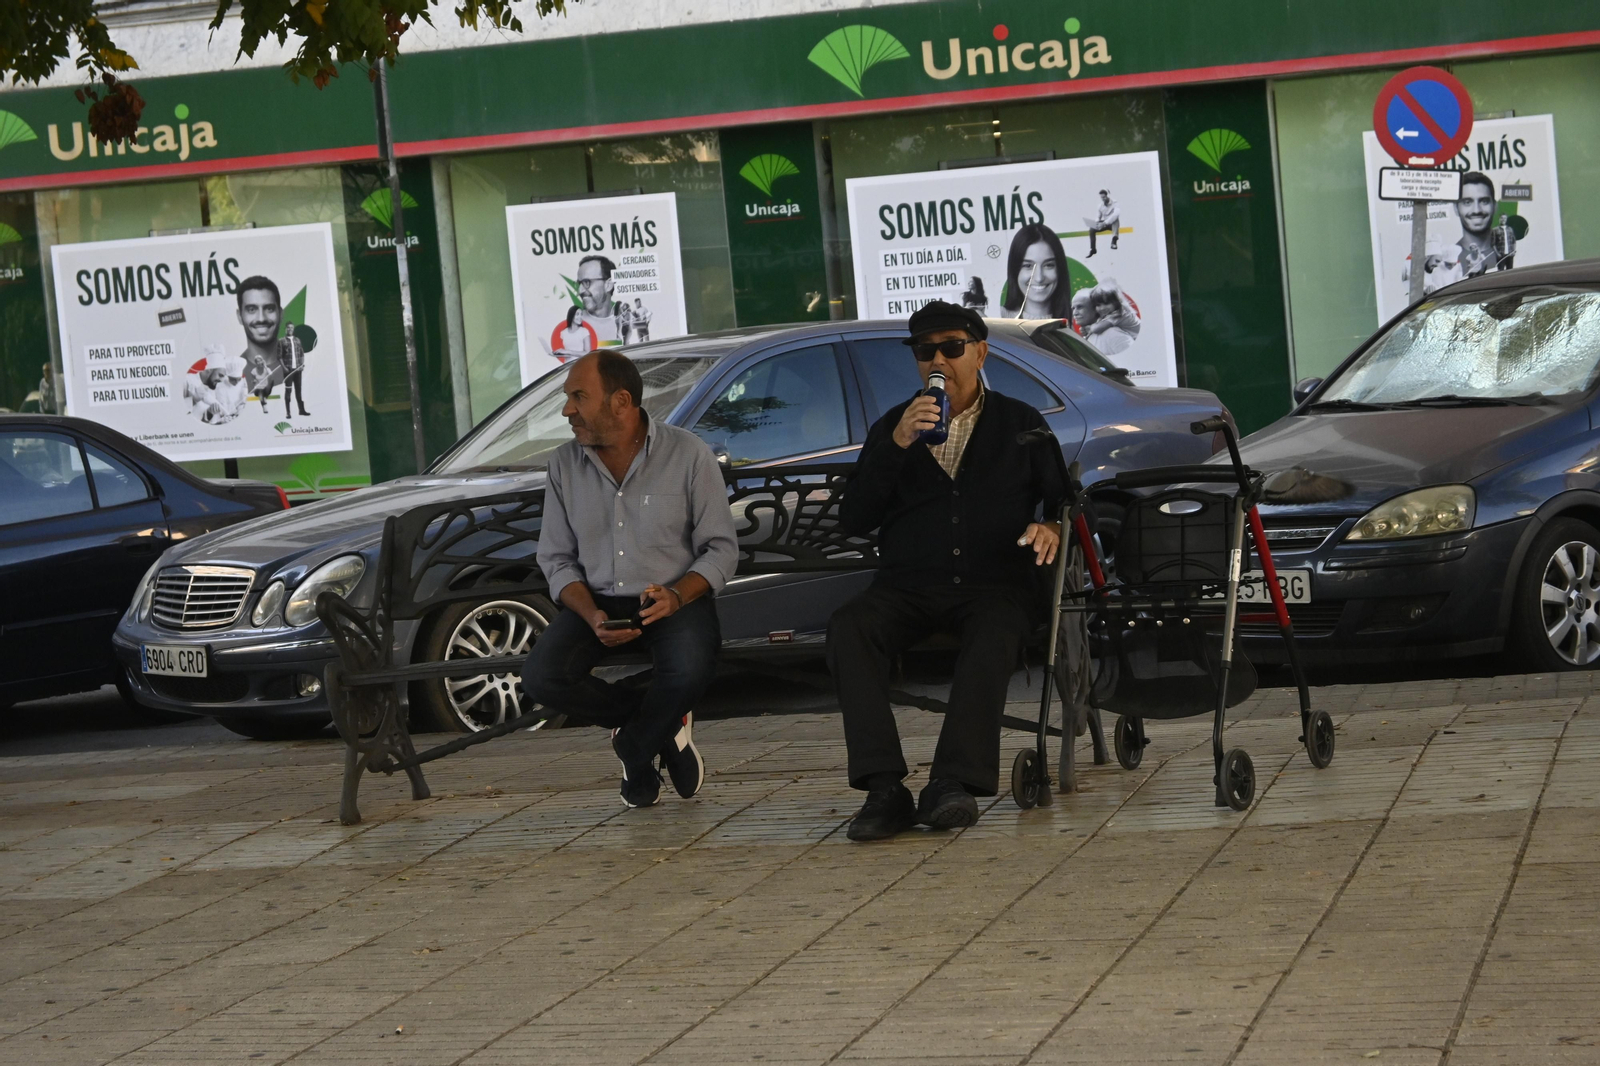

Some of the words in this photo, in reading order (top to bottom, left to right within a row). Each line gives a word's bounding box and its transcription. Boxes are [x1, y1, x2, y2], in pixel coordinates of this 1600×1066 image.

[921, 17, 1112, 80] Unicaja
[1477, 134, 1527, 171] MÁS
[1193, 174, 1252, 194] Unicaja
[1505, 188, 1530, 197] ABIERTO
[745, 198, 801, 217] Unicaja
[879, 197, 975, 241] SOMOS
[982, 185, 1045, 232] MÁS
[530, 224, 604, 256] SOMOS
[610, 216, 658, 250] MÁS
[622, 255, 656, 265] CERCANOS.
[884, 253, 898, 267] EN
[900, 252, 914, 266] TU
[916, 248, 934, 264] DÍA
[936, 250, 944, 263] A
[946, 245, 967, 262] DÍA.
[76, 263, 172, 306] SOMOS
[179, 252, 241, 298] MÁS
[614, 269, 658, 279] INNOVADORES.
[886, 277, 900, 291] EN
[902, 276, 916, 289] TU
[918, 272, 960, 288] TIEMPO.
[617, 283, 659, 293] SOSTENIBLES.
[888, 301, 902, 314] EN
[904, 299, 918, 313] TU
[89, 347, 112, 359] PARA
[113, 346, 126, 358] TU
[126, 343, 174, 357] PROYECTO.
[91, 368, 115, 381] PARA
[116, 367, 128, 379] TU
[129, 364, 170, 378] NEGOCIO.
[93, 389, 117, 402] PARA
[118, 388, 130, 400] TU
[131, 386, 169, 400] ILUSIÓN.
[146, 648, 174, 672] 6904
[179, 650, 204, 673] CRD
